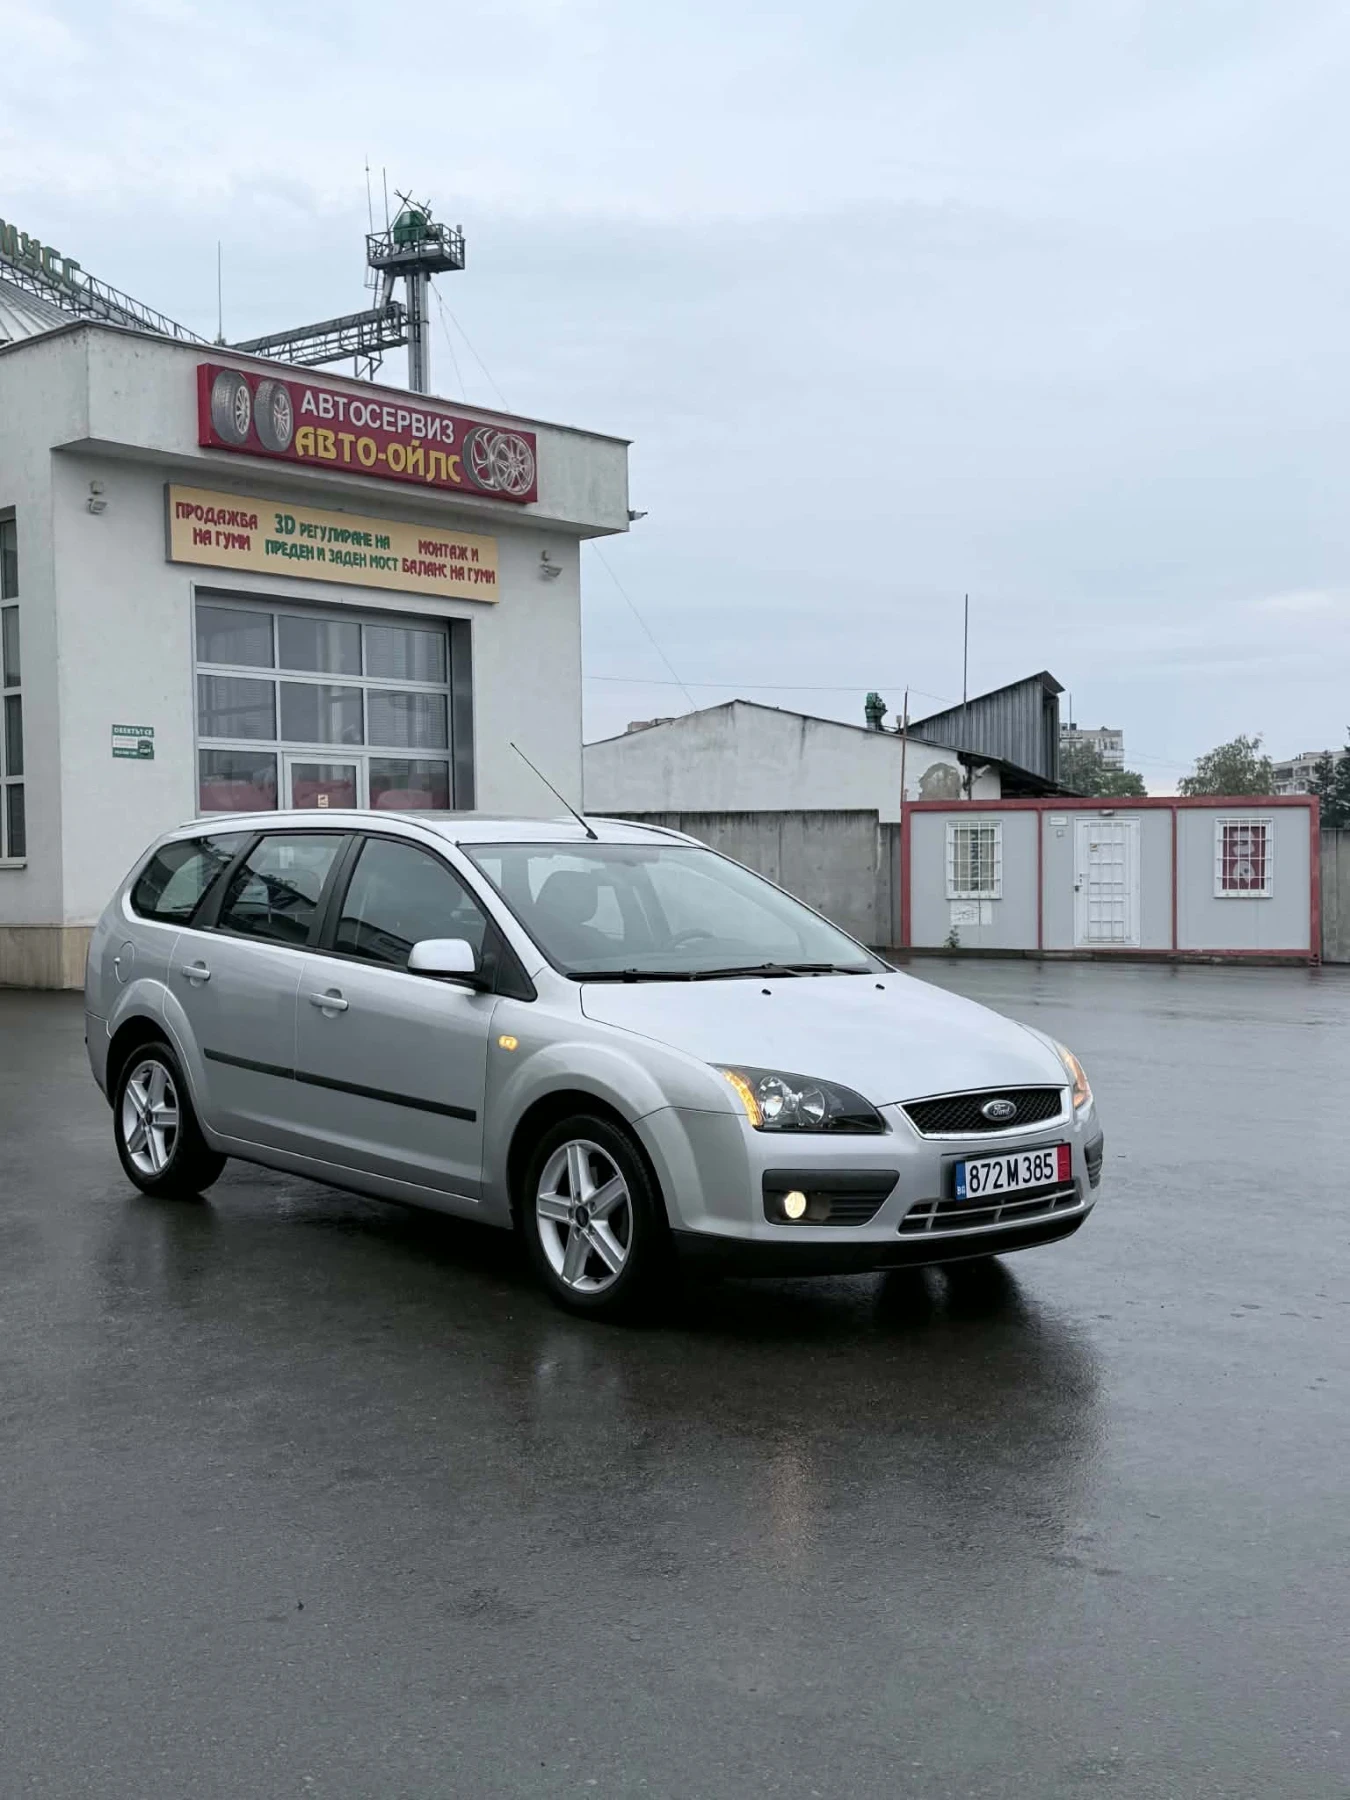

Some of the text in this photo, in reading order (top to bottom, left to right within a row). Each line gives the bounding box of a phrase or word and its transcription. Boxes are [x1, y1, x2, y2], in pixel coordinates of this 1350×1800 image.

[301, 390, 455, 444] АВТОСЕРВИЗ
[295, 426, 461, 483] АВТО-ОЙЛС
[175, 501, 258, 530] ПРОДАЖБА
[193, 527, 251, 551] НА ГУМИ
[274, 513, 391, 550] 3D РЕГУЛИРАНЕ НА
[265, 539, 399, 572] ПРЕДЕН И ЗАДЕН МОСТ
[418, 539, 479, 563] МОНТАЖ И
[402, 557, 496, 584] БАЛАНС НА ГУМИ
